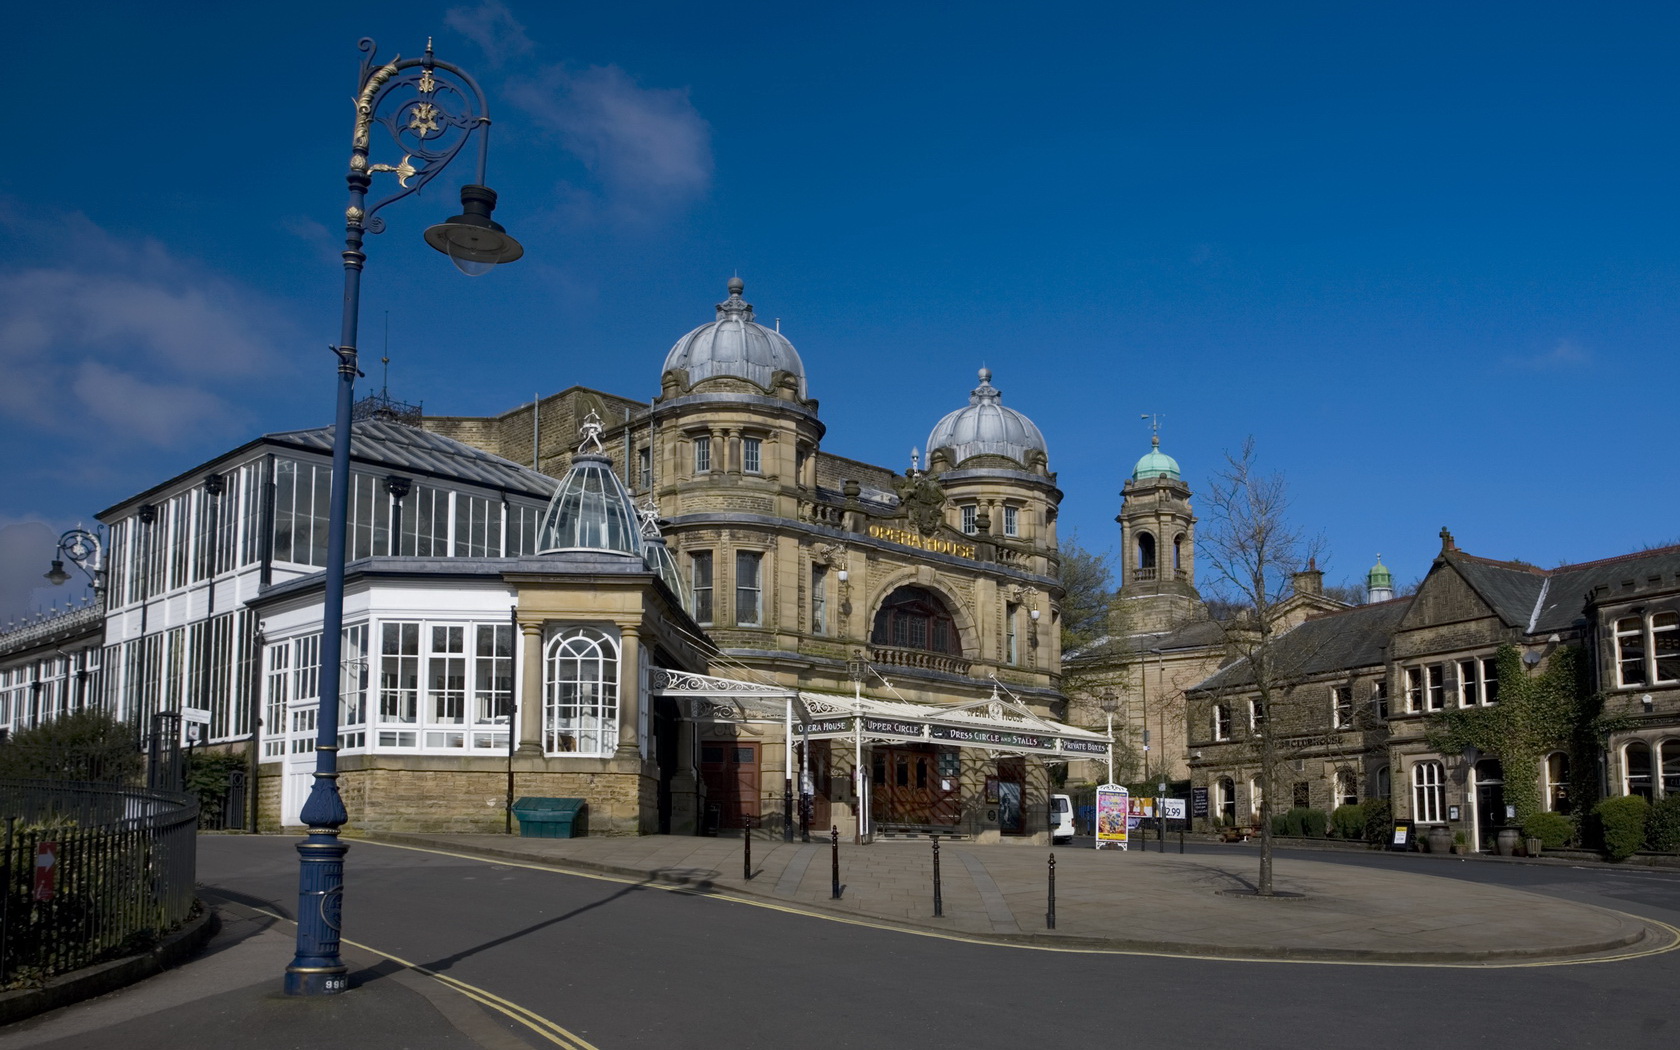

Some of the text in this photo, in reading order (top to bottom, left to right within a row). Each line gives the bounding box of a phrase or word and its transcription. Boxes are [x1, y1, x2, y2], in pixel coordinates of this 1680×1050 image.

[869, 524, 976, 561] OPERA HOUSE
[798, 722, 846, 733] OERA HOUSE
[867, 720, 919, 734] UPPER CIRCLE
[950, 729, 973, 740] DRESS
[974, 731, 1000, 743] CIRCLE
[1012, 736, 1038, 746] STALLS
[1063, 741, 1106, 752] PRIVATE BOXES
